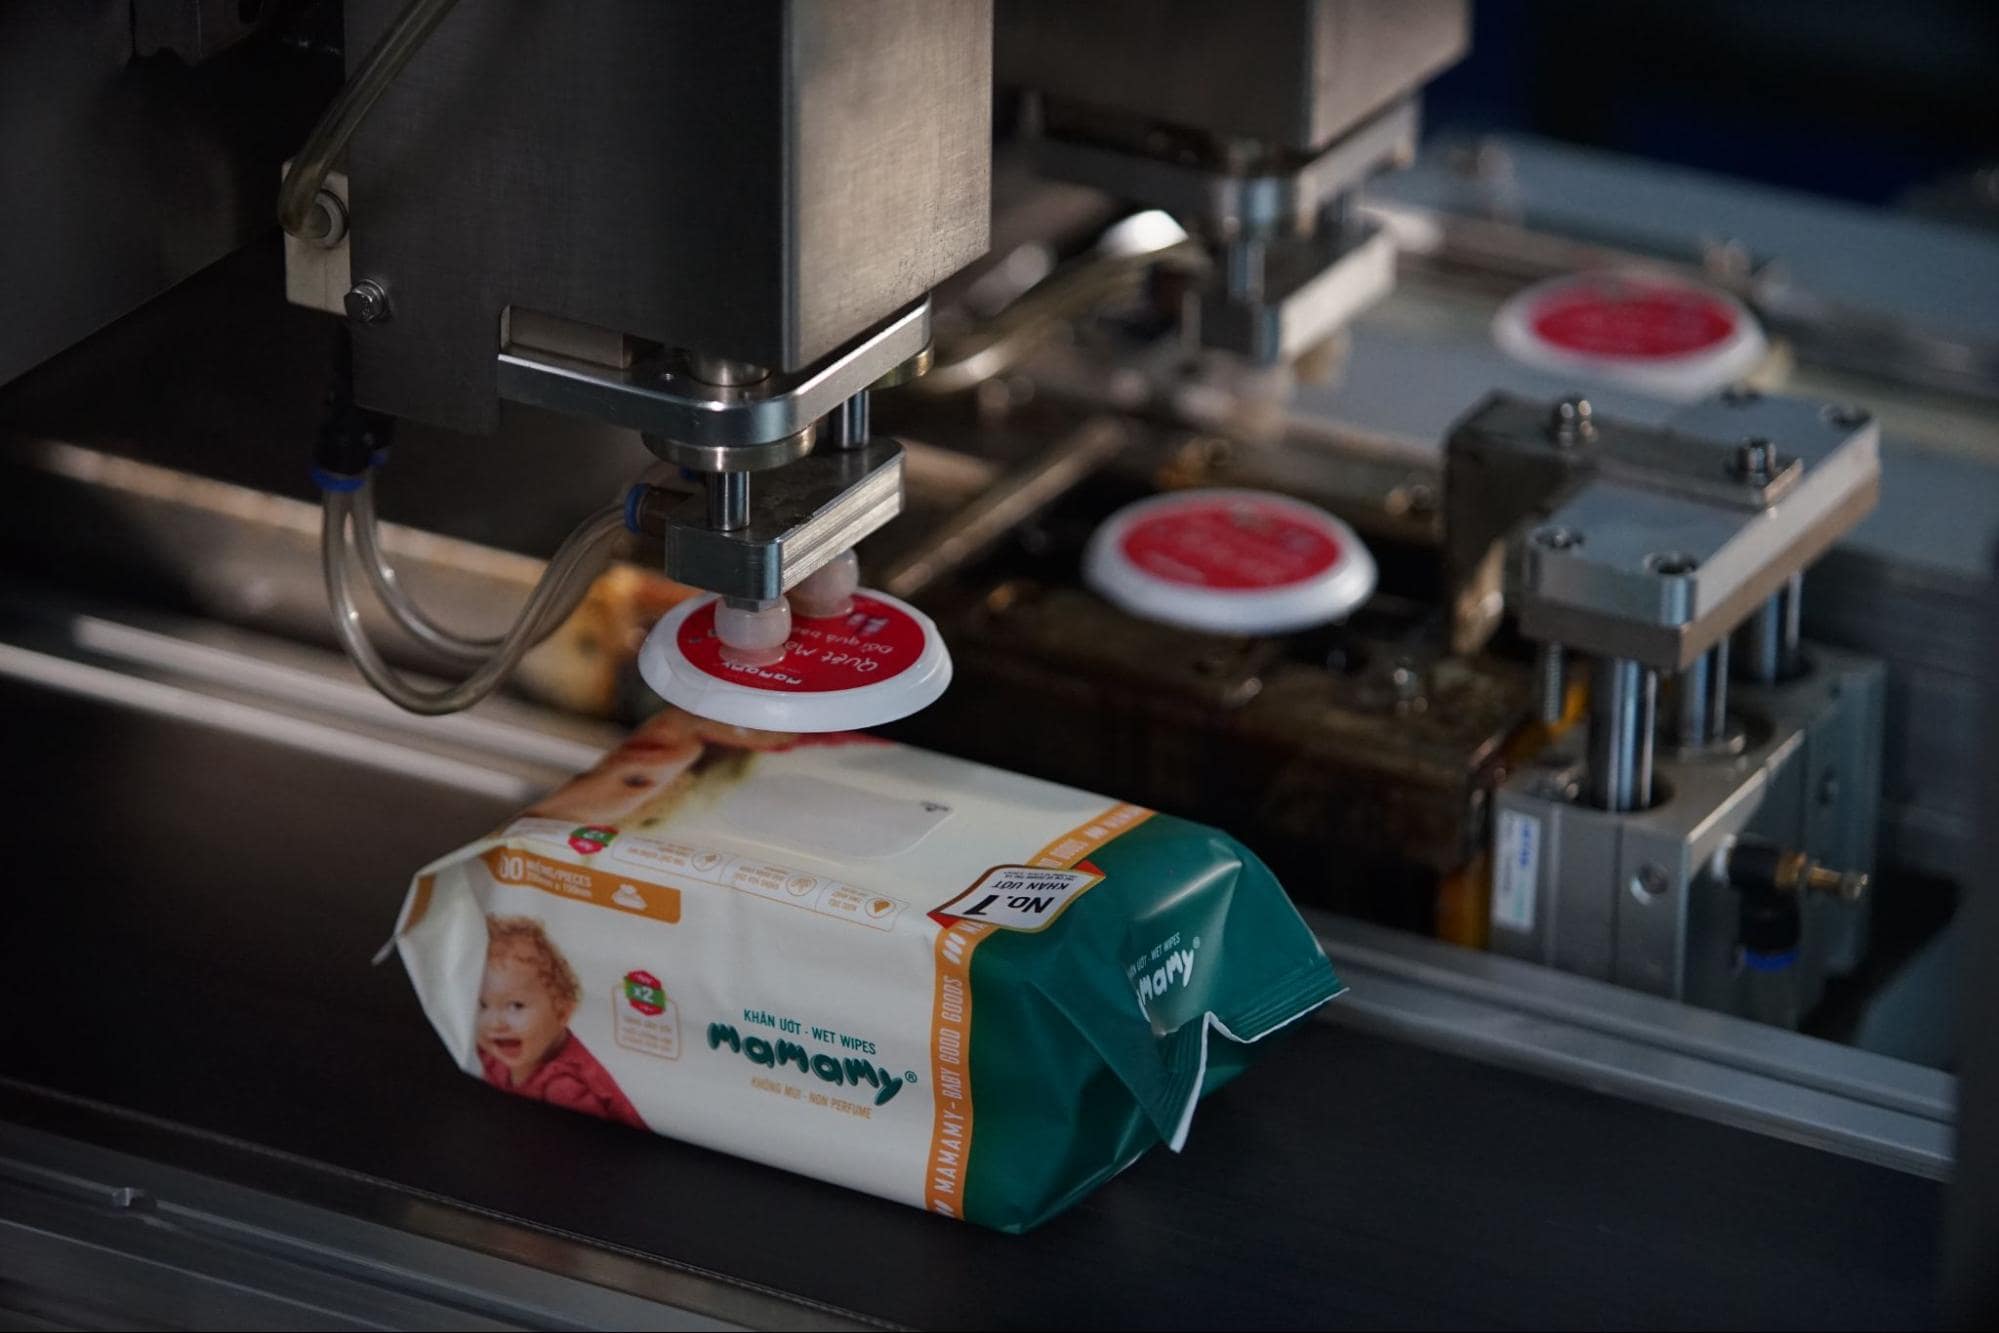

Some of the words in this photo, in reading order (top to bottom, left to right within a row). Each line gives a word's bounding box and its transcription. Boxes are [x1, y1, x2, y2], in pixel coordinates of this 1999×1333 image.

[963, 894, 1000, 916] 1
[942, 975, 964, 1023] GOODS
[812, 1026, 837, 1044] WET
[839, 1033, 877, 1056] WIPES
[939, 1026, 961, 1065] GOOD
